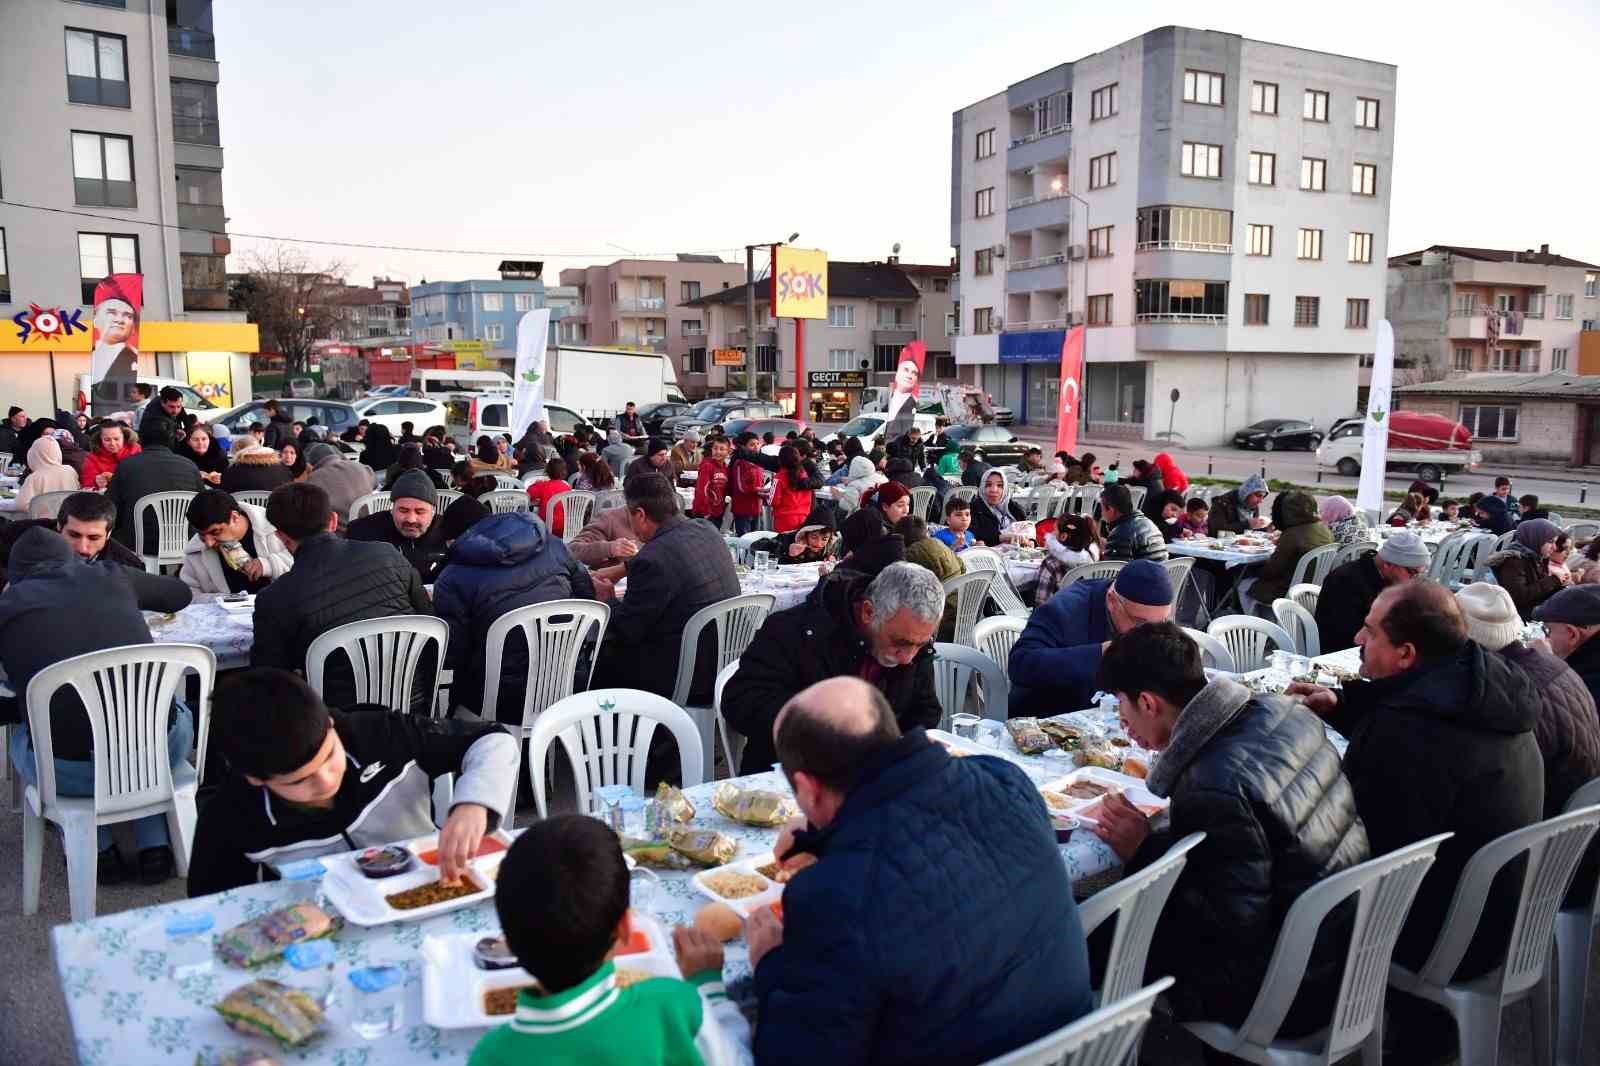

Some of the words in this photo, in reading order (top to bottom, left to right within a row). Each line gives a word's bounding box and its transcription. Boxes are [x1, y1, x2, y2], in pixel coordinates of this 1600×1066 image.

[779, 271, 824, 303] ŞOK
[13, 308, 88, 344] ŞOK
[811, 372, 840, 382] GEÇİT
